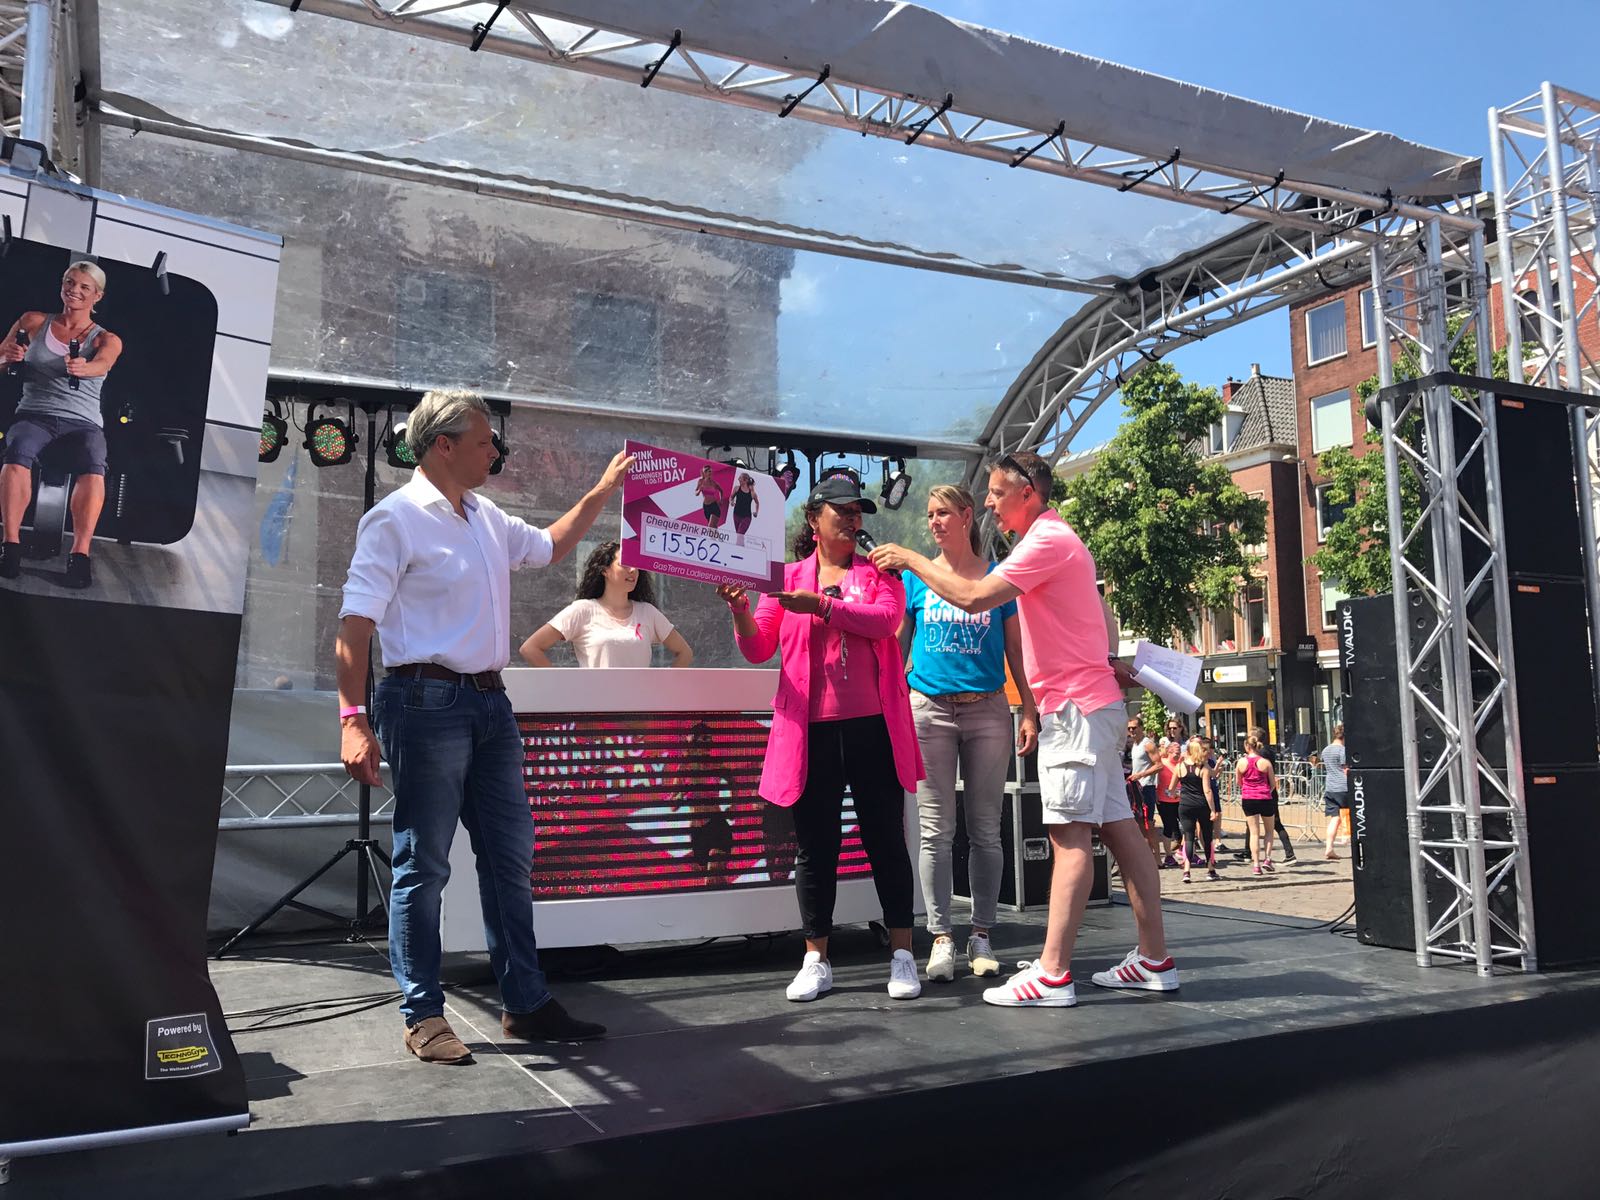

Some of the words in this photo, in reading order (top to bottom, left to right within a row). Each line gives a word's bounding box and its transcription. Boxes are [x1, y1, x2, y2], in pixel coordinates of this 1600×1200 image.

[632, 450, 653, 461] PINK
[627, 456, 678, 474] RUNNING
[631, 471, 663, 481] GRONINGEN
[663, 468, 687, 483] DAY
[646, 515, 680, 530] Cheque
[680, 523, 700, 535] Pink
[700, 528, 730, 542] Ribbon
[652, 561, 686, 575] GasTerra
[924, 622, 991, 650] DAY
[157, 1023, 191, 1037] Powered
[192, 1022, 203, 1034] by
